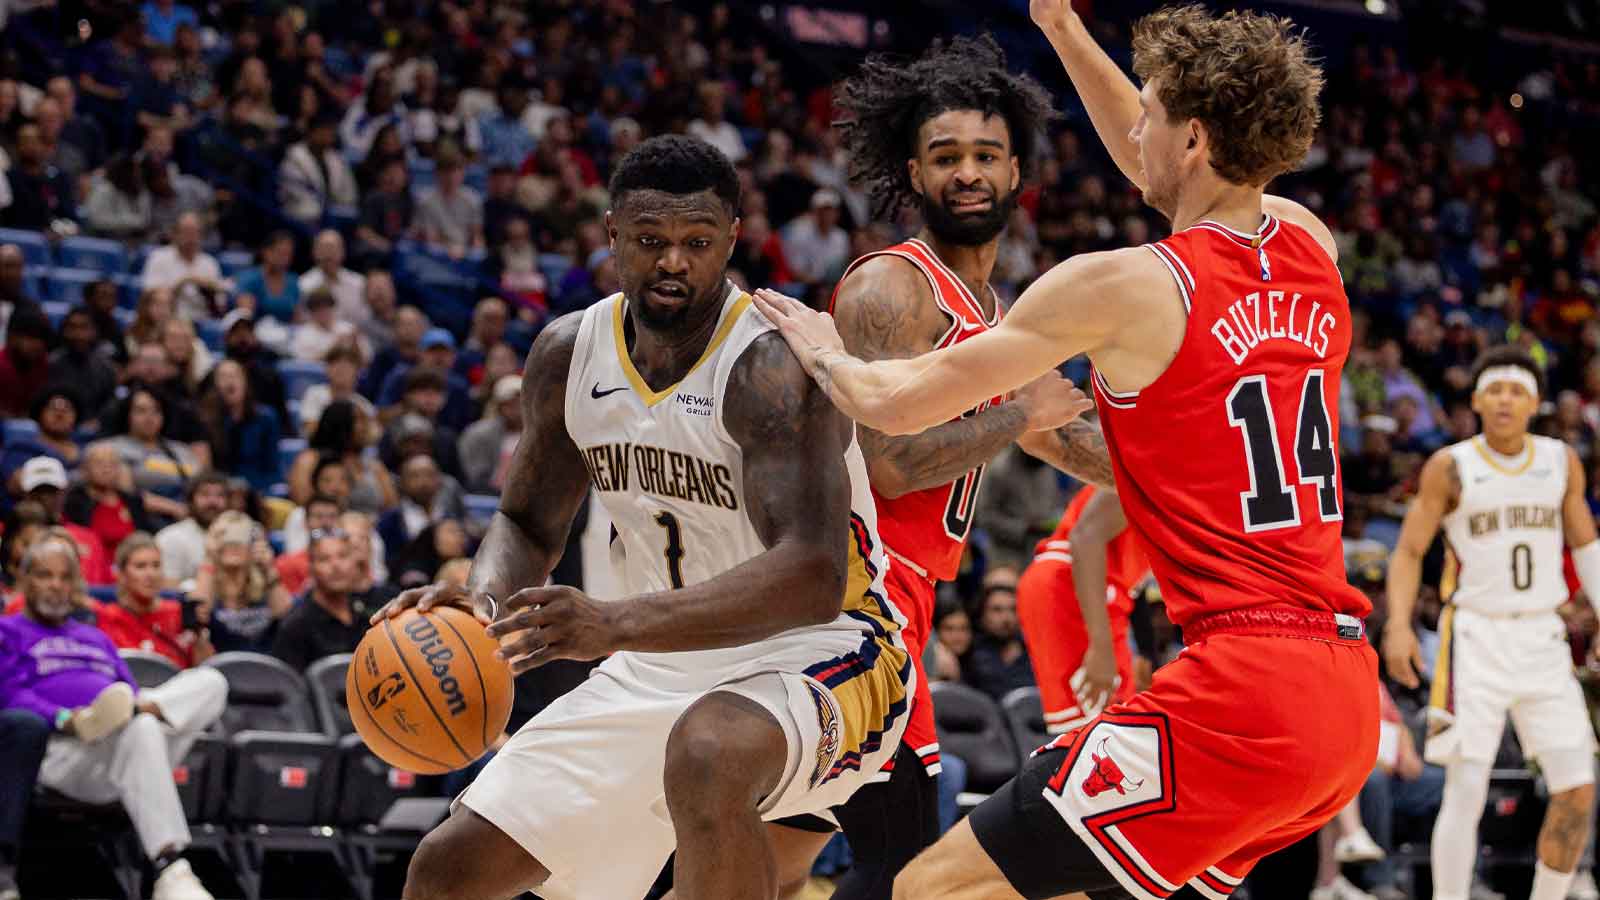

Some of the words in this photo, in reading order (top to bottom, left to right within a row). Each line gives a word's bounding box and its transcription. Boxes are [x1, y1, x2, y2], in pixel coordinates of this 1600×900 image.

[1210, 290, 1336, 366] BUZELIS
[634, 445, 738, 511] ORLEANS
[1225, 368, 1343, 533] 14
[653, 509, 685, 589] 1
[1511, 543, 1532, 591] 0
[405, 615, 467, 717] Wilson
